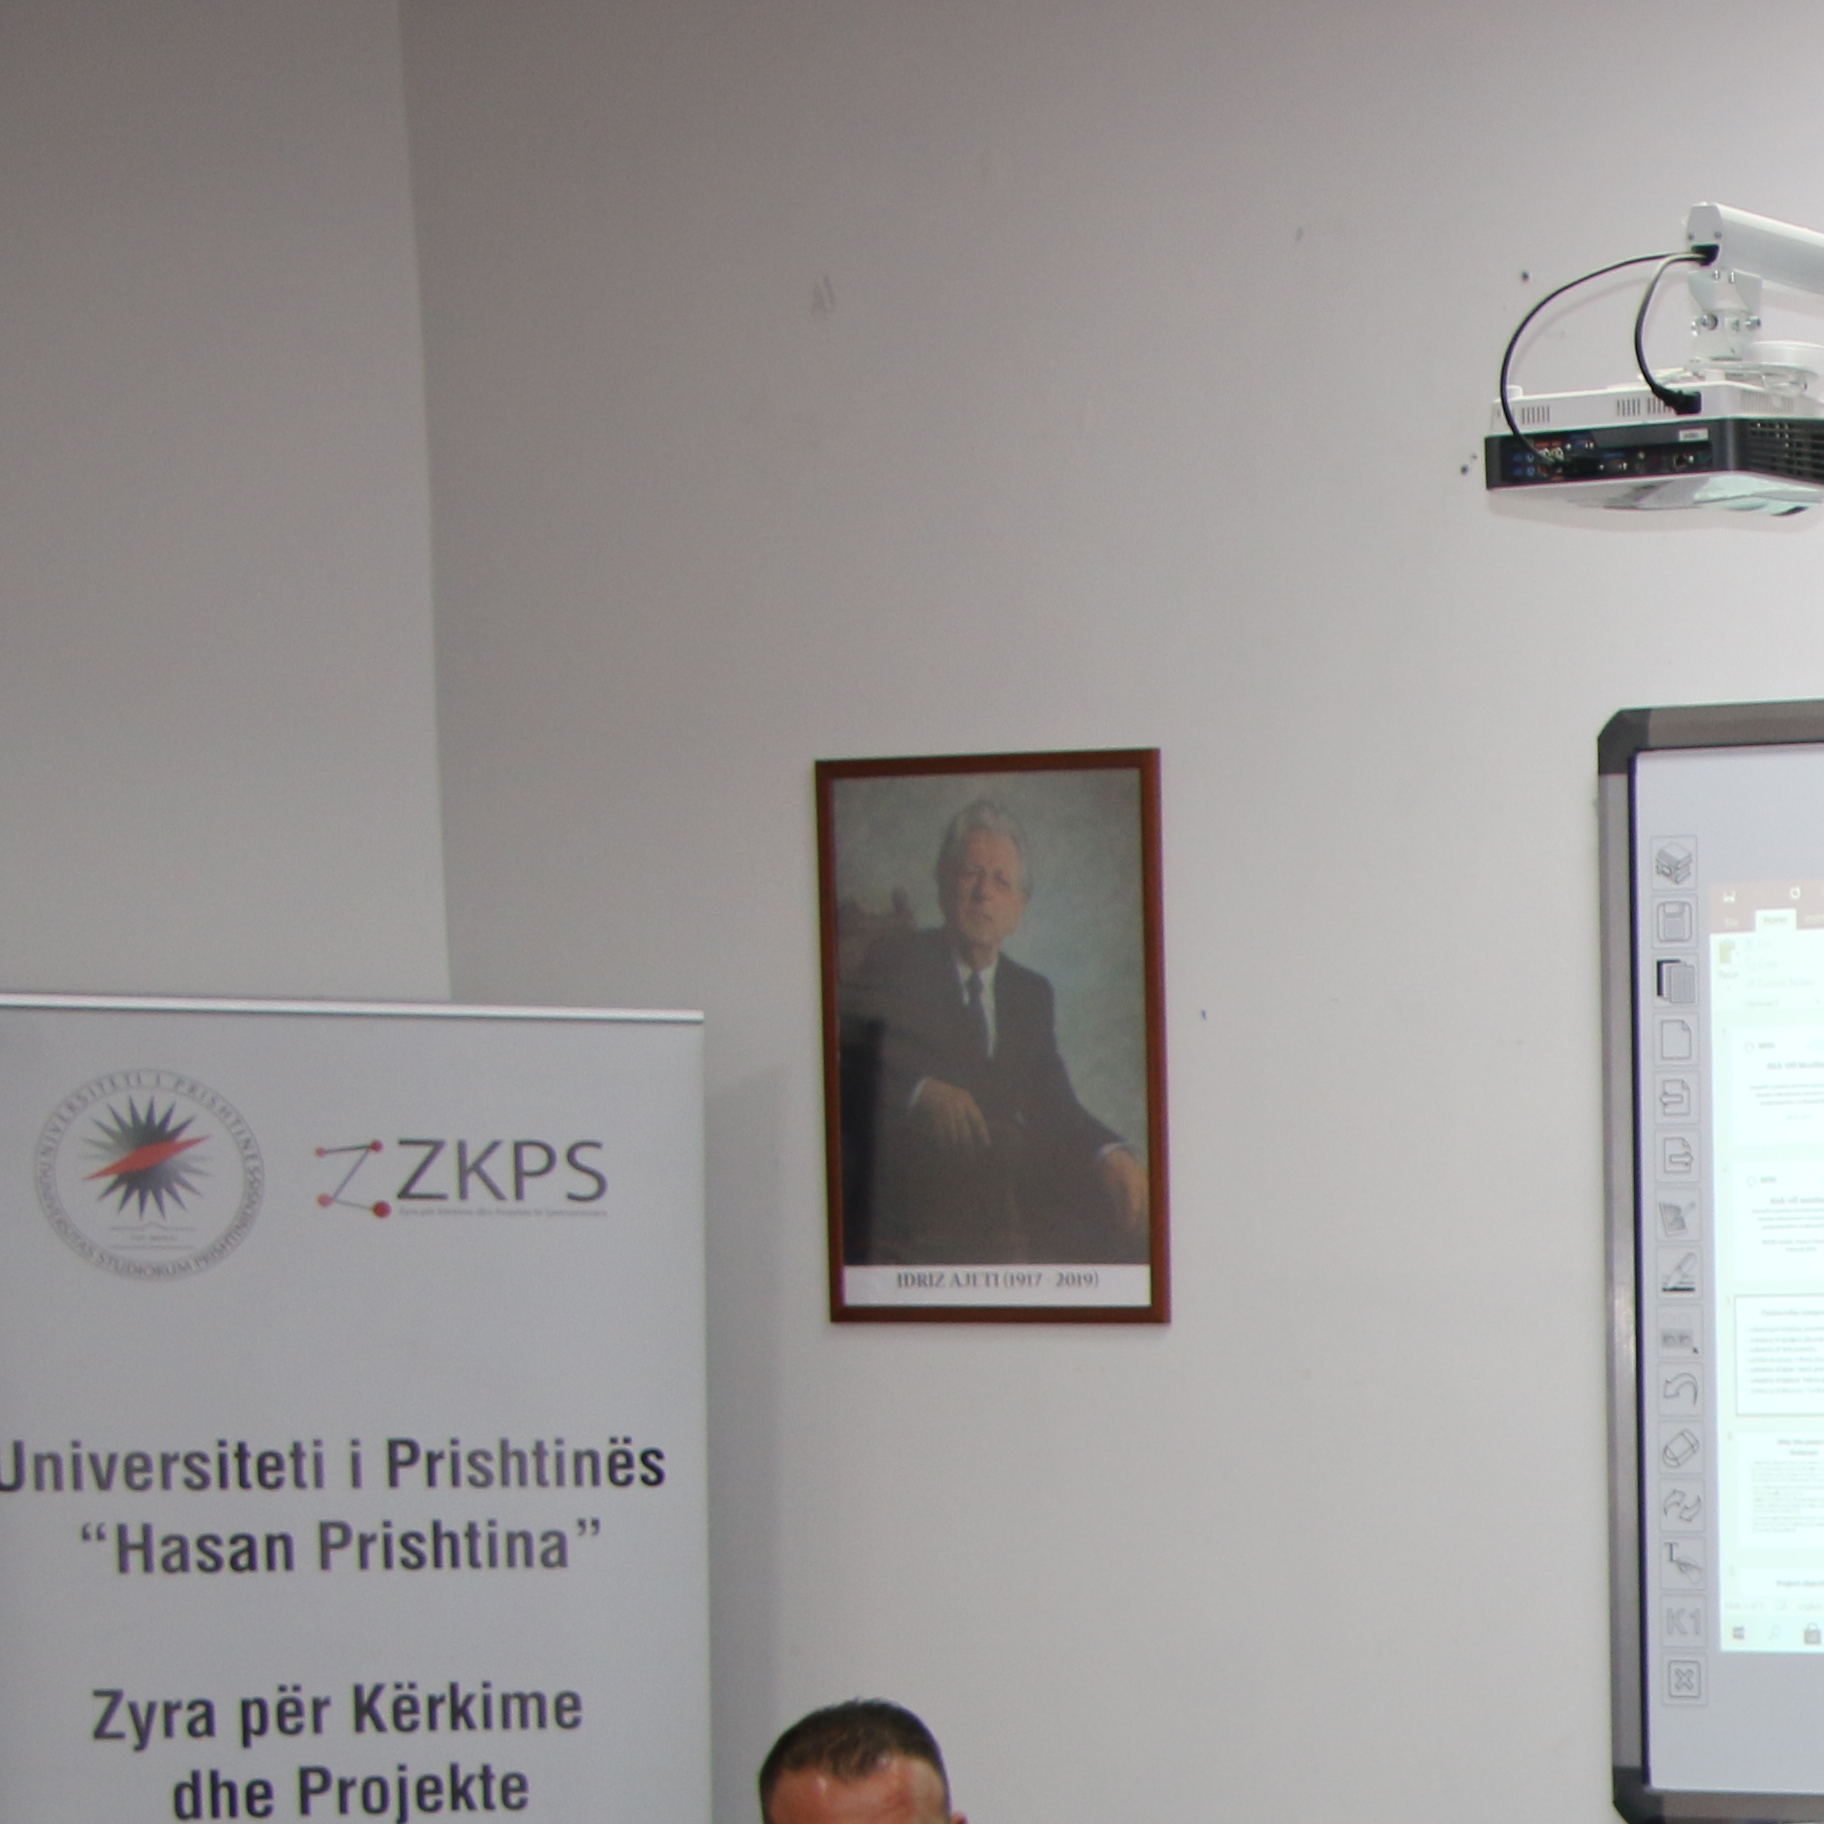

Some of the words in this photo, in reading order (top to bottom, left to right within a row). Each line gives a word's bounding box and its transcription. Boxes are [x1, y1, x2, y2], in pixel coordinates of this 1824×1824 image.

[397, 1138, 608, 1203] ZKPS
[897, 1271, 946, 1288] IDRIZ
[0, 1438, 326, 1493] Universiteti
[350, 1438, 363, 1489] i
[386, 1436, 667, 1490] Prishtinës
[80, 1520, 295, 1575] “Hasan
[318, 1517, 601, 1571] Prishtina”
[93, 1688, 216, 1752] Zyra
[241, 1684, 331, 1747] për
[352, 1681, 583, 1734] Kërkime
[173, 1769, 275, 1821] dhe
[298, 1762, 530, 1824] Projekte
